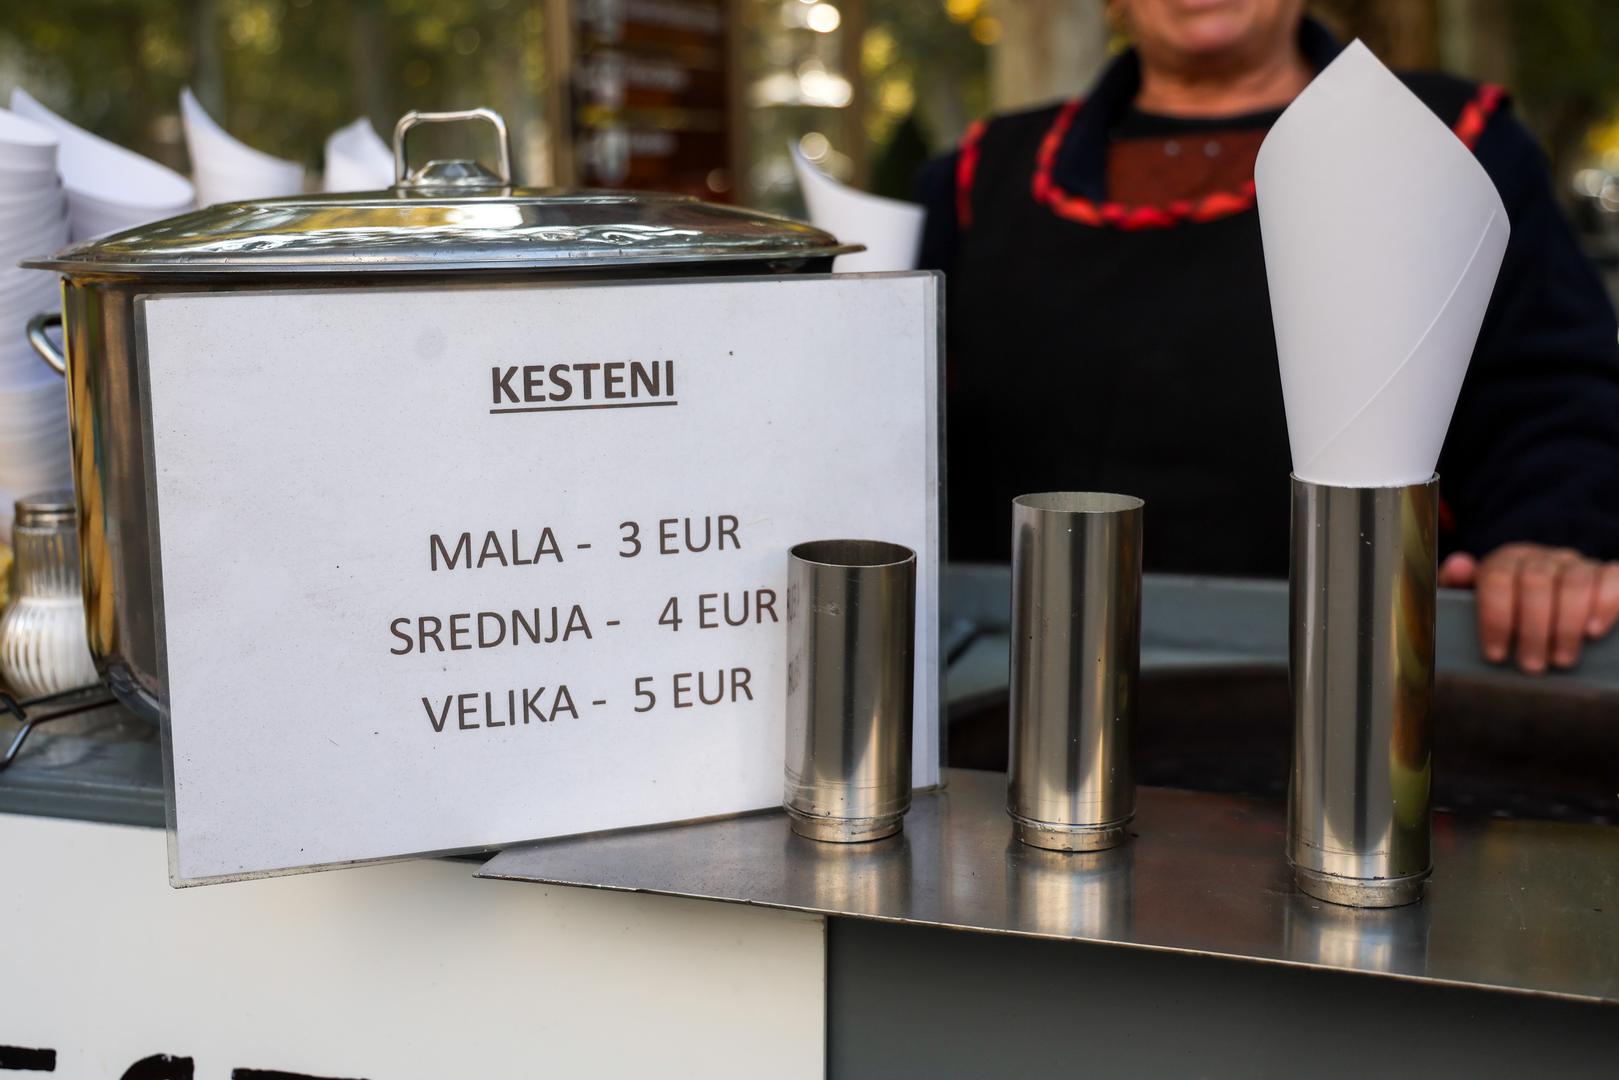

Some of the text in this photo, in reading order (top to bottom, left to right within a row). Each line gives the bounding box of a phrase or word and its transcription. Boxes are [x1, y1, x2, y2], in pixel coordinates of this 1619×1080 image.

[491, 360, 676, 405] KESTENI
[430, 527, 564, 571] MALA
[619, 521, 642, 558] 3
[659, 515, 742, 555] EUR
[389, 604, 593, 656] SREDNJA
[658, 596, 683, 632] 4
[698, 589, 779, 629] EUR
[421, 685, 579, 733] VELIKA
[634, 676, 656, 713] 5
[673, 667, 754, 709] EUR
